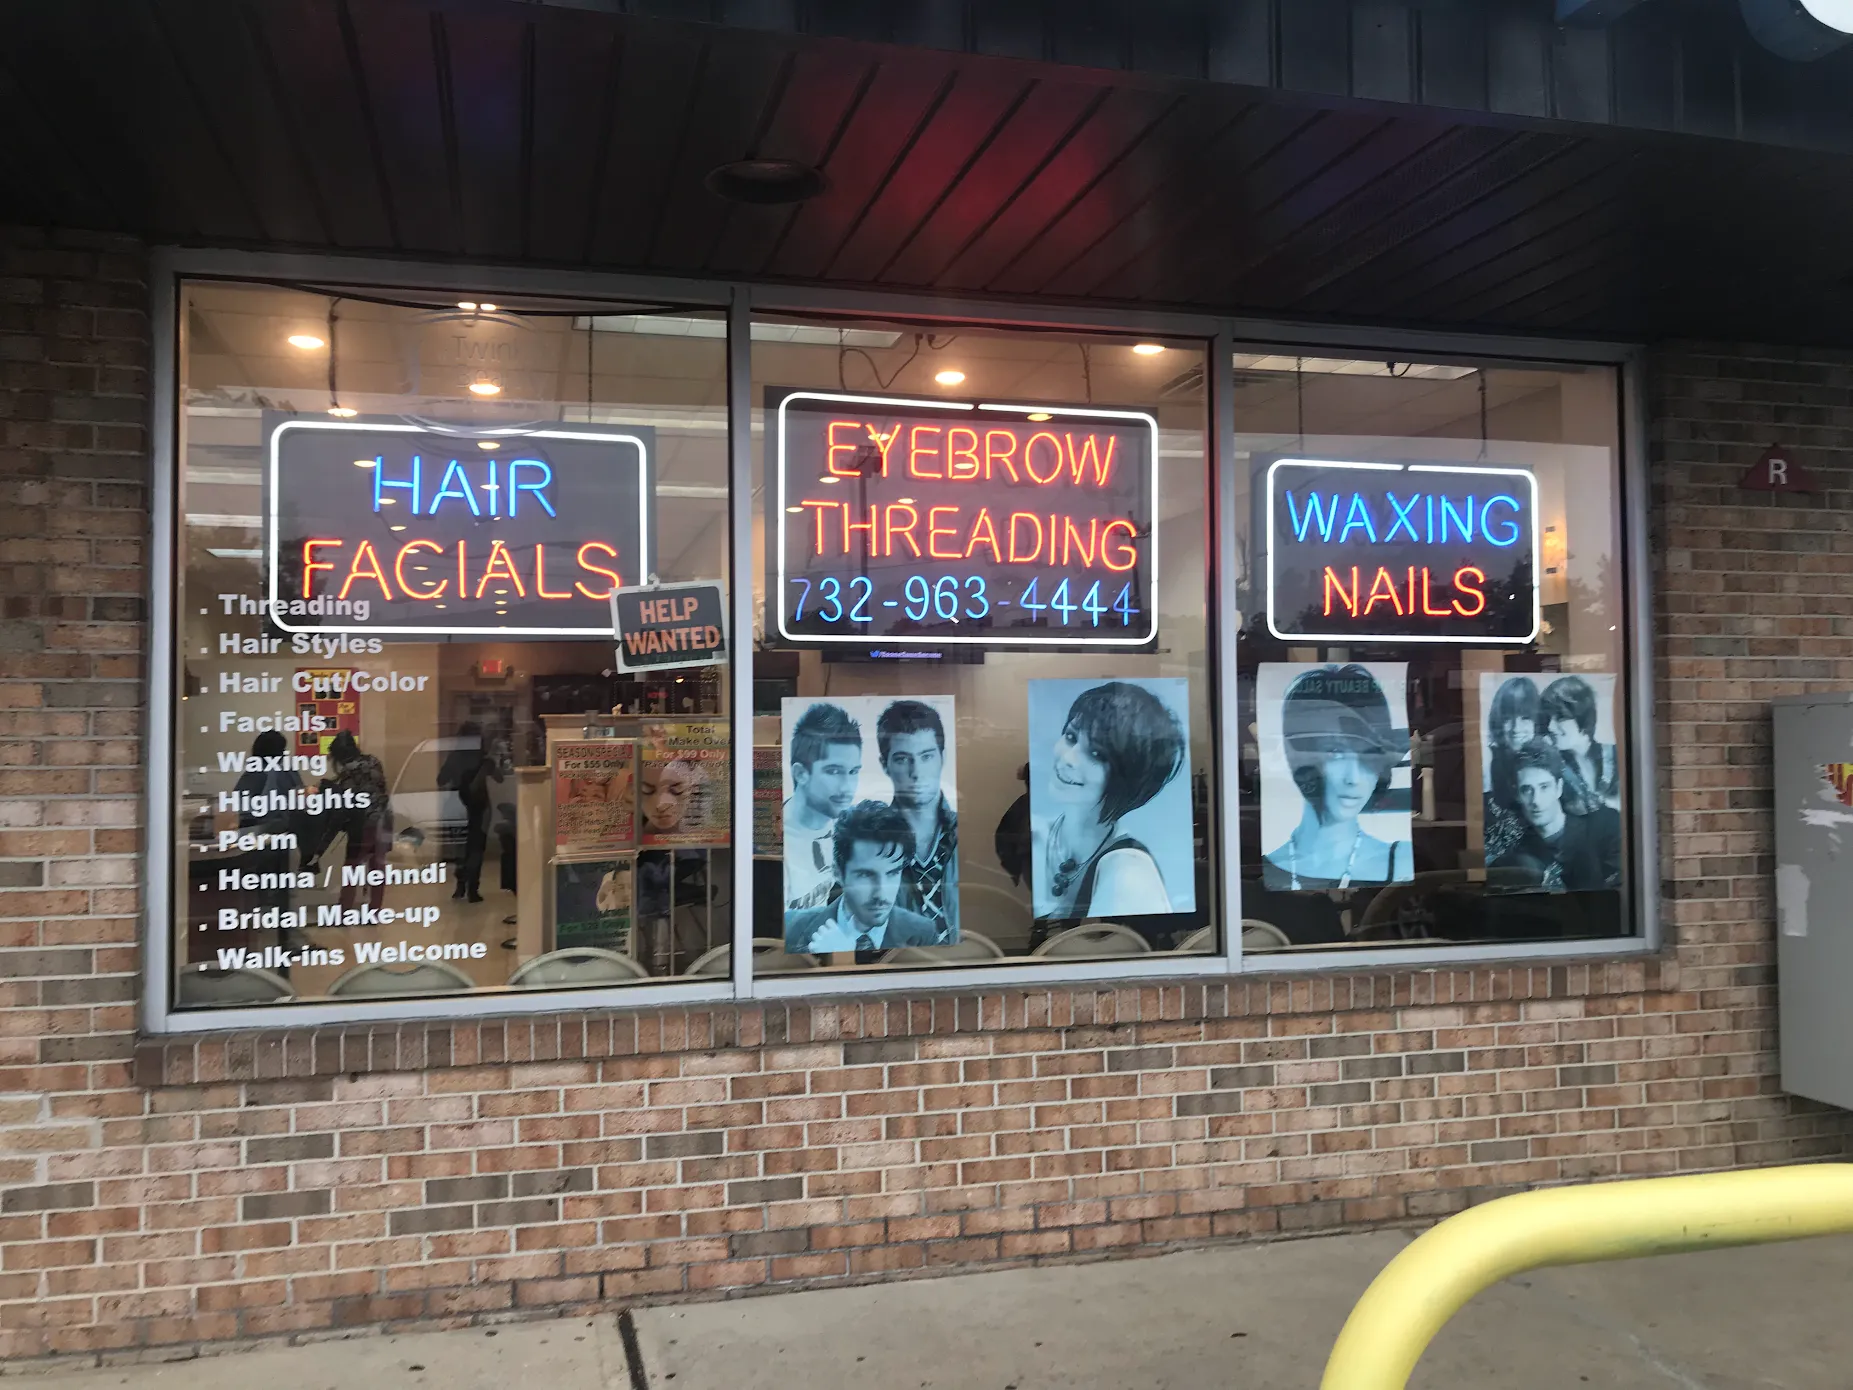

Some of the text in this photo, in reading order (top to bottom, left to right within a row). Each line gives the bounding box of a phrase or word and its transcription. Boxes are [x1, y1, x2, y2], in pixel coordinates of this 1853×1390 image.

[828, 420, 1117, 487] EYEBROW
[371, 454, 557, 518] HAIR
[1767, 458, 1788, 486] R
[1285, 488, 1522, 547] WAXING
[800, 499, 1138, 572] THREADING
[302, 538, 622, 602] FACIALS
[790, 574, 1141, 629] 732-963-4444
[1322, 564, 1487, 618] NAILS
[218, 593, 371, 622] Threading
[639, 596, 699, 625] HELP
[218, 632, 383, 659] Hair Styles
[624, 624, 721, 656] WANTED
[218, 671, 282, 694] Hair
[291, 670, 429, 694] Cut/Color
[218, 710, 326, 734] Facials
[556, 746, 594, 759] SEASON
[655, 749, 726, 761] For $99 Only
[668, 736, 700, 747] Make
[217, 750, 328, 777] Waxing
[564, 759, 627, 770] For $55 Only
[218, 788, 372, 818] Highlights
[218, 829, 298, 853] Perm
[218, 861, 448, 891] Henna / Mehndi
[218, 902, 440, 931] Bridal Make-up
[217, 938, 488, 971] Walk-ins Welcome
